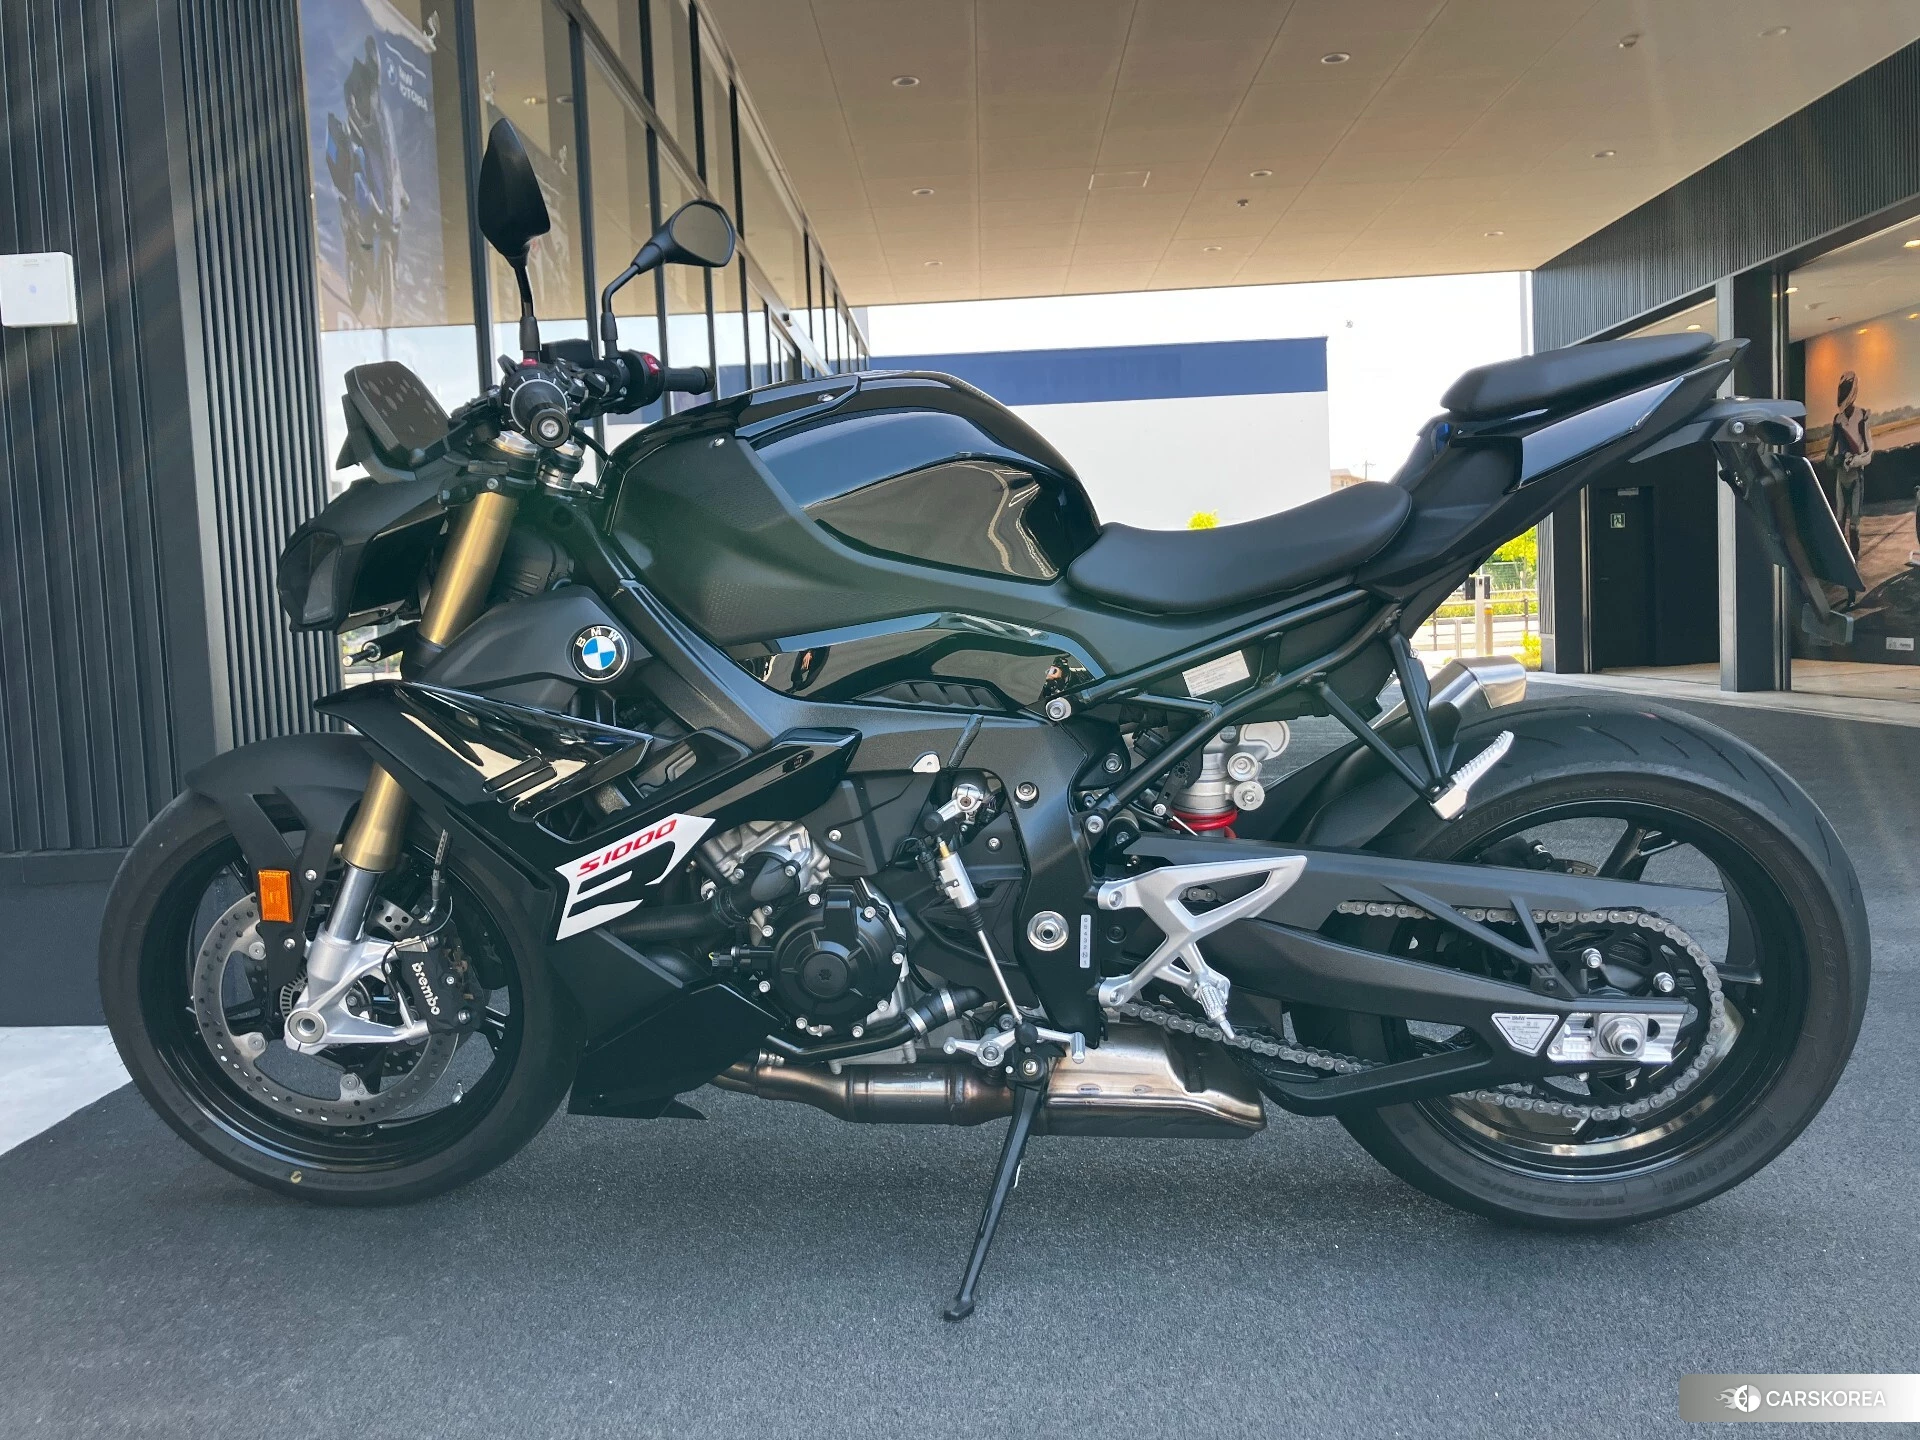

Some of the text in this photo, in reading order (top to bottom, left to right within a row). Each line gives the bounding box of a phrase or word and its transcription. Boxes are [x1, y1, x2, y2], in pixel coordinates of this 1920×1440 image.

[575, 627, 620, 648] BMW
[578, 818, 678, 872] S1000
[411, 961, 441, 1016] brembo
